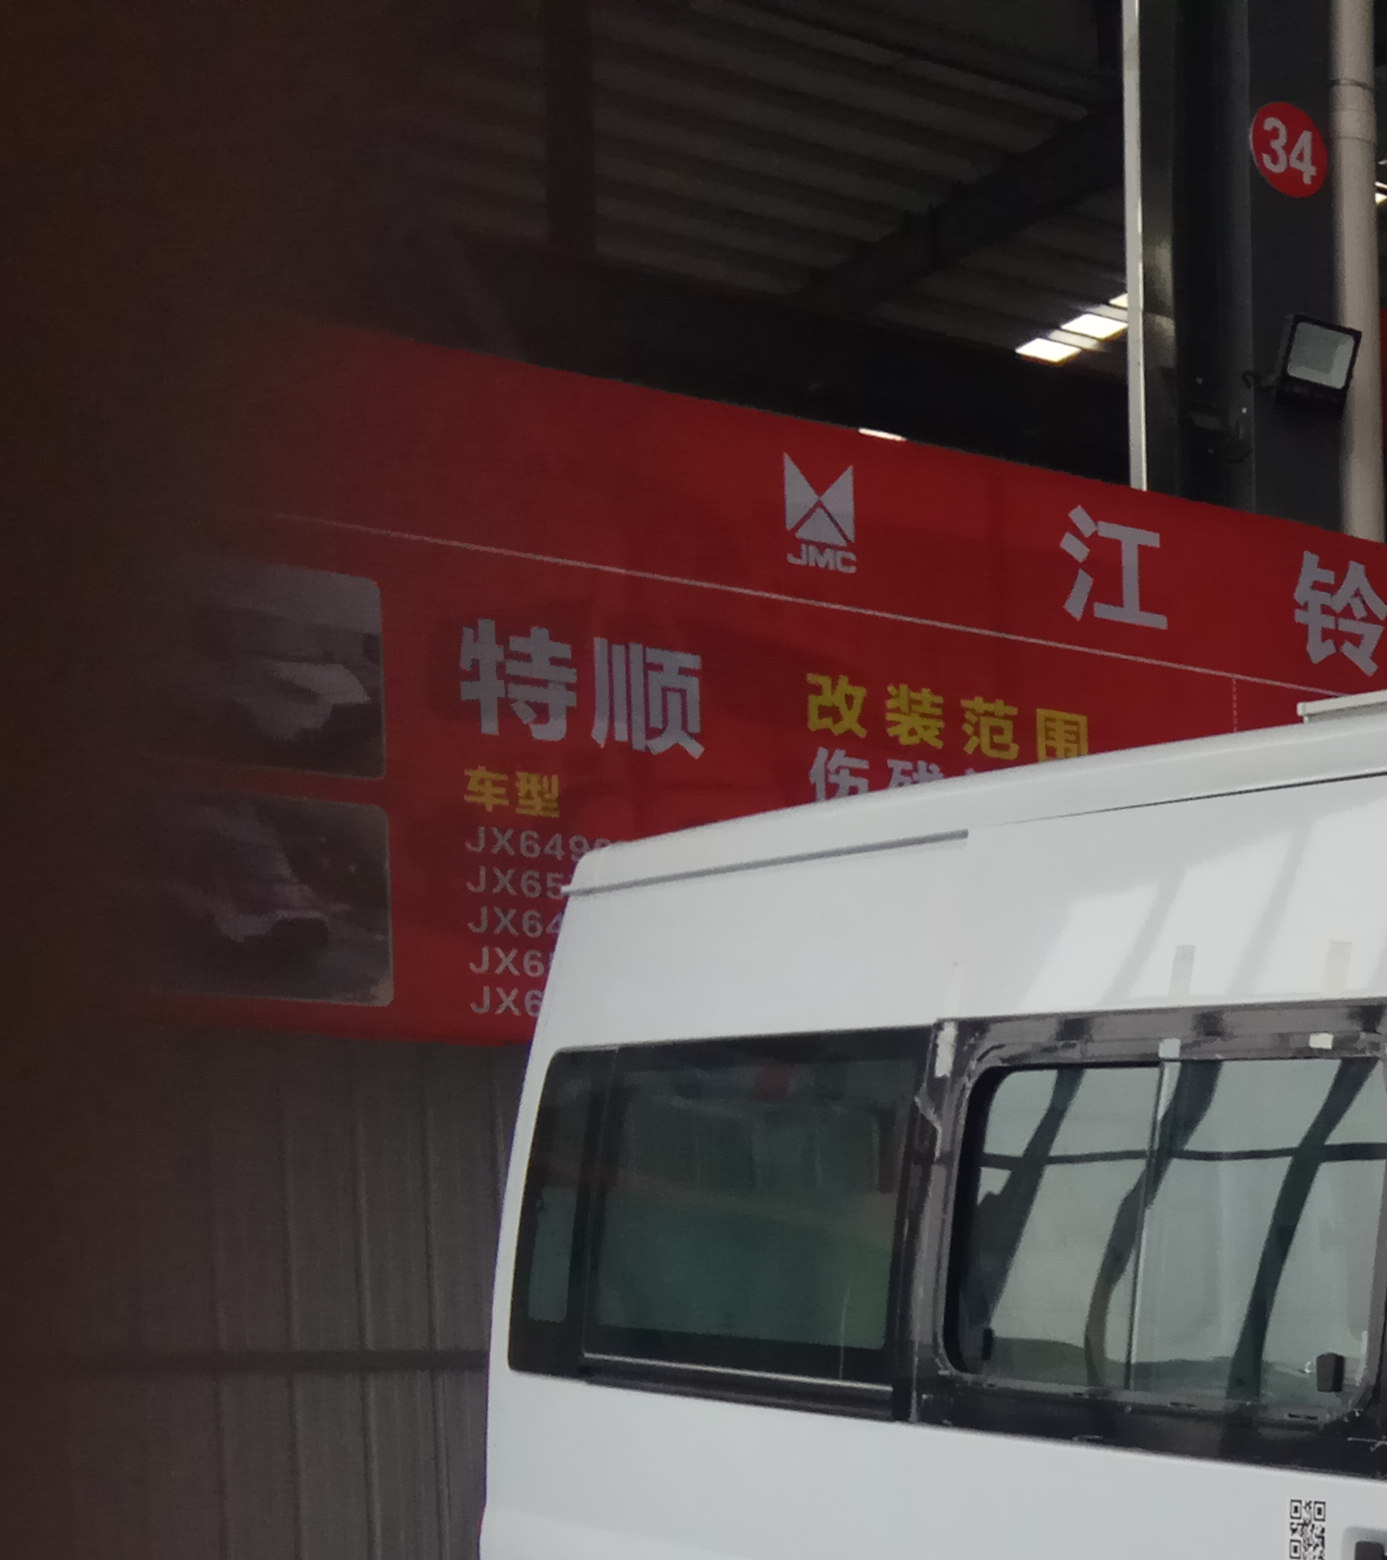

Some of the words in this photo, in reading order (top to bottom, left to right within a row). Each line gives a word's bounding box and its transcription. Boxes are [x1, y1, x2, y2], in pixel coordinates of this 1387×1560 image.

[1262, 116, 1317, 185] 34
[787, 551, 857, 575] JMC
[459, 618, 705, 759] 特顺
[806, 672, 1089, 762] 改装范围
[464, 765, 560, 818] 车型
